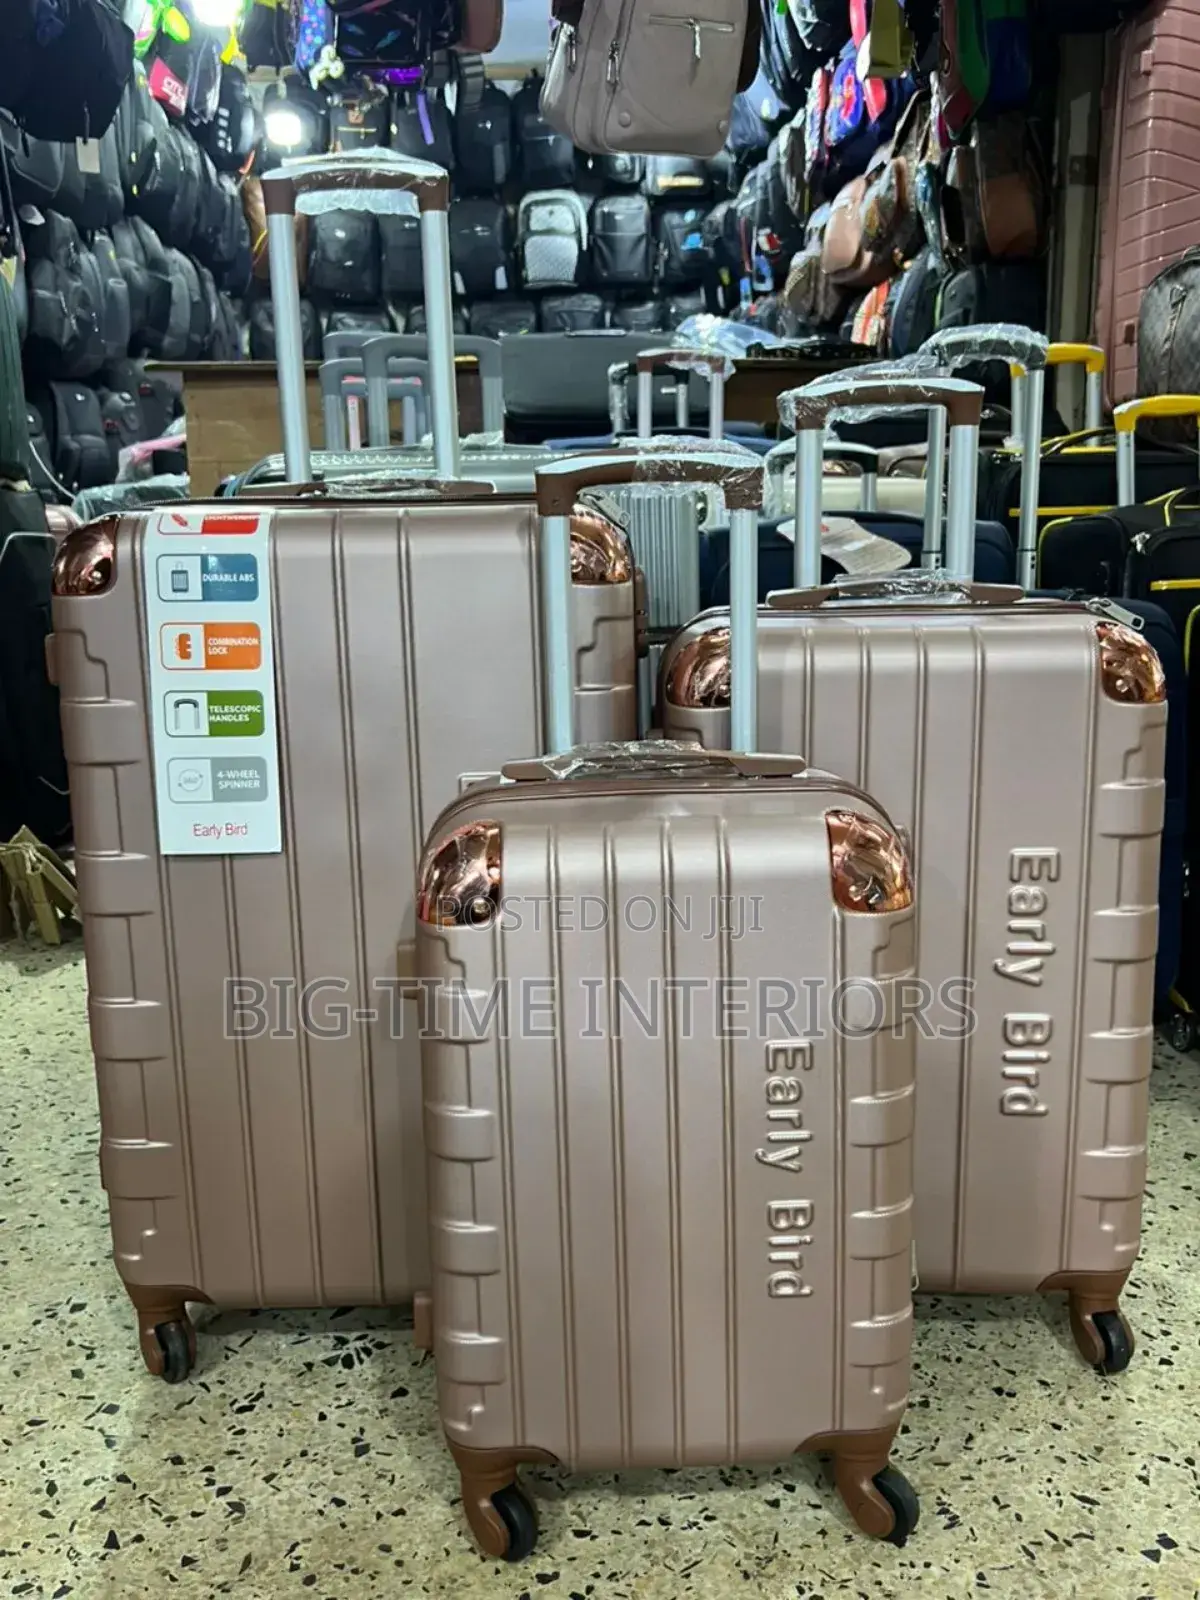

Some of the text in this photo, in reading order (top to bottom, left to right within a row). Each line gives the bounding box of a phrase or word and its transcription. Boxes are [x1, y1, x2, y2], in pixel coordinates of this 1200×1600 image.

[202, 573, 255, 582] DURABLE ABS
[208, 637, 260, 646] COMBINATION
[208, 646, 228, 655] LOCK
[209, 704, 262, 714] TELESCOPIC
[209, 714, 250, 722] HANDLES
[217, 769, 261, 780] 4-WHEEL
[218, 779, 261, 789] SPINNER
[193, 822, 249, 840] Early Bird
[993, 847, 1061, 1117] Early Bird
[754, 1038, 815, 1299] Early Bird
